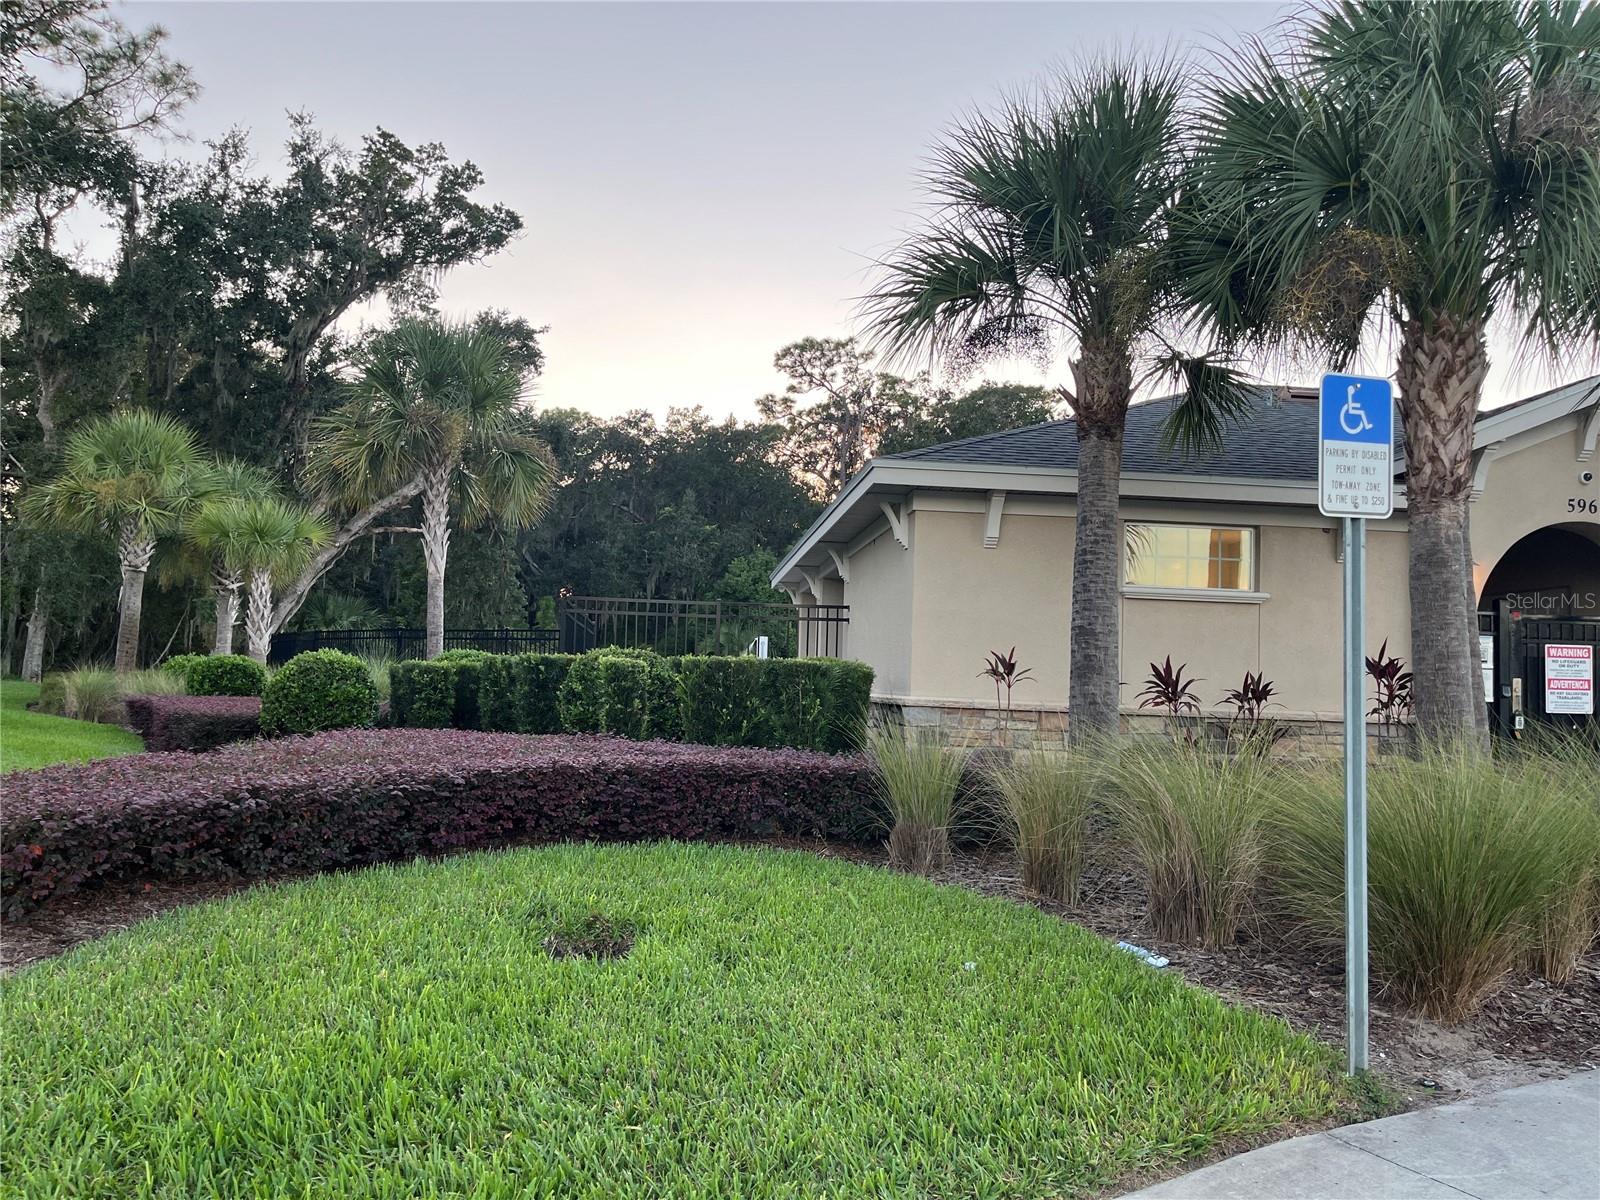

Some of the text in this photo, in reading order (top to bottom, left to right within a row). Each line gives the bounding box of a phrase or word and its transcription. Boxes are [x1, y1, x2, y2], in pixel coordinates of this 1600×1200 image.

[1326, 448, 1386, 460] PARKING BY DISABLED
[1336, 464, 1376, 475] PERMIT ONLY
[1332, 480, 1381, 492] TOW-AWAY ZONE
[1327, 493, 1385, 506] & FINE UP TO $250
[1567, 498, 1598, 515] 596
[1550, 648, 1589, 657] WARNING
[1550, 680, 1589, 689] ADVERTENCIA
